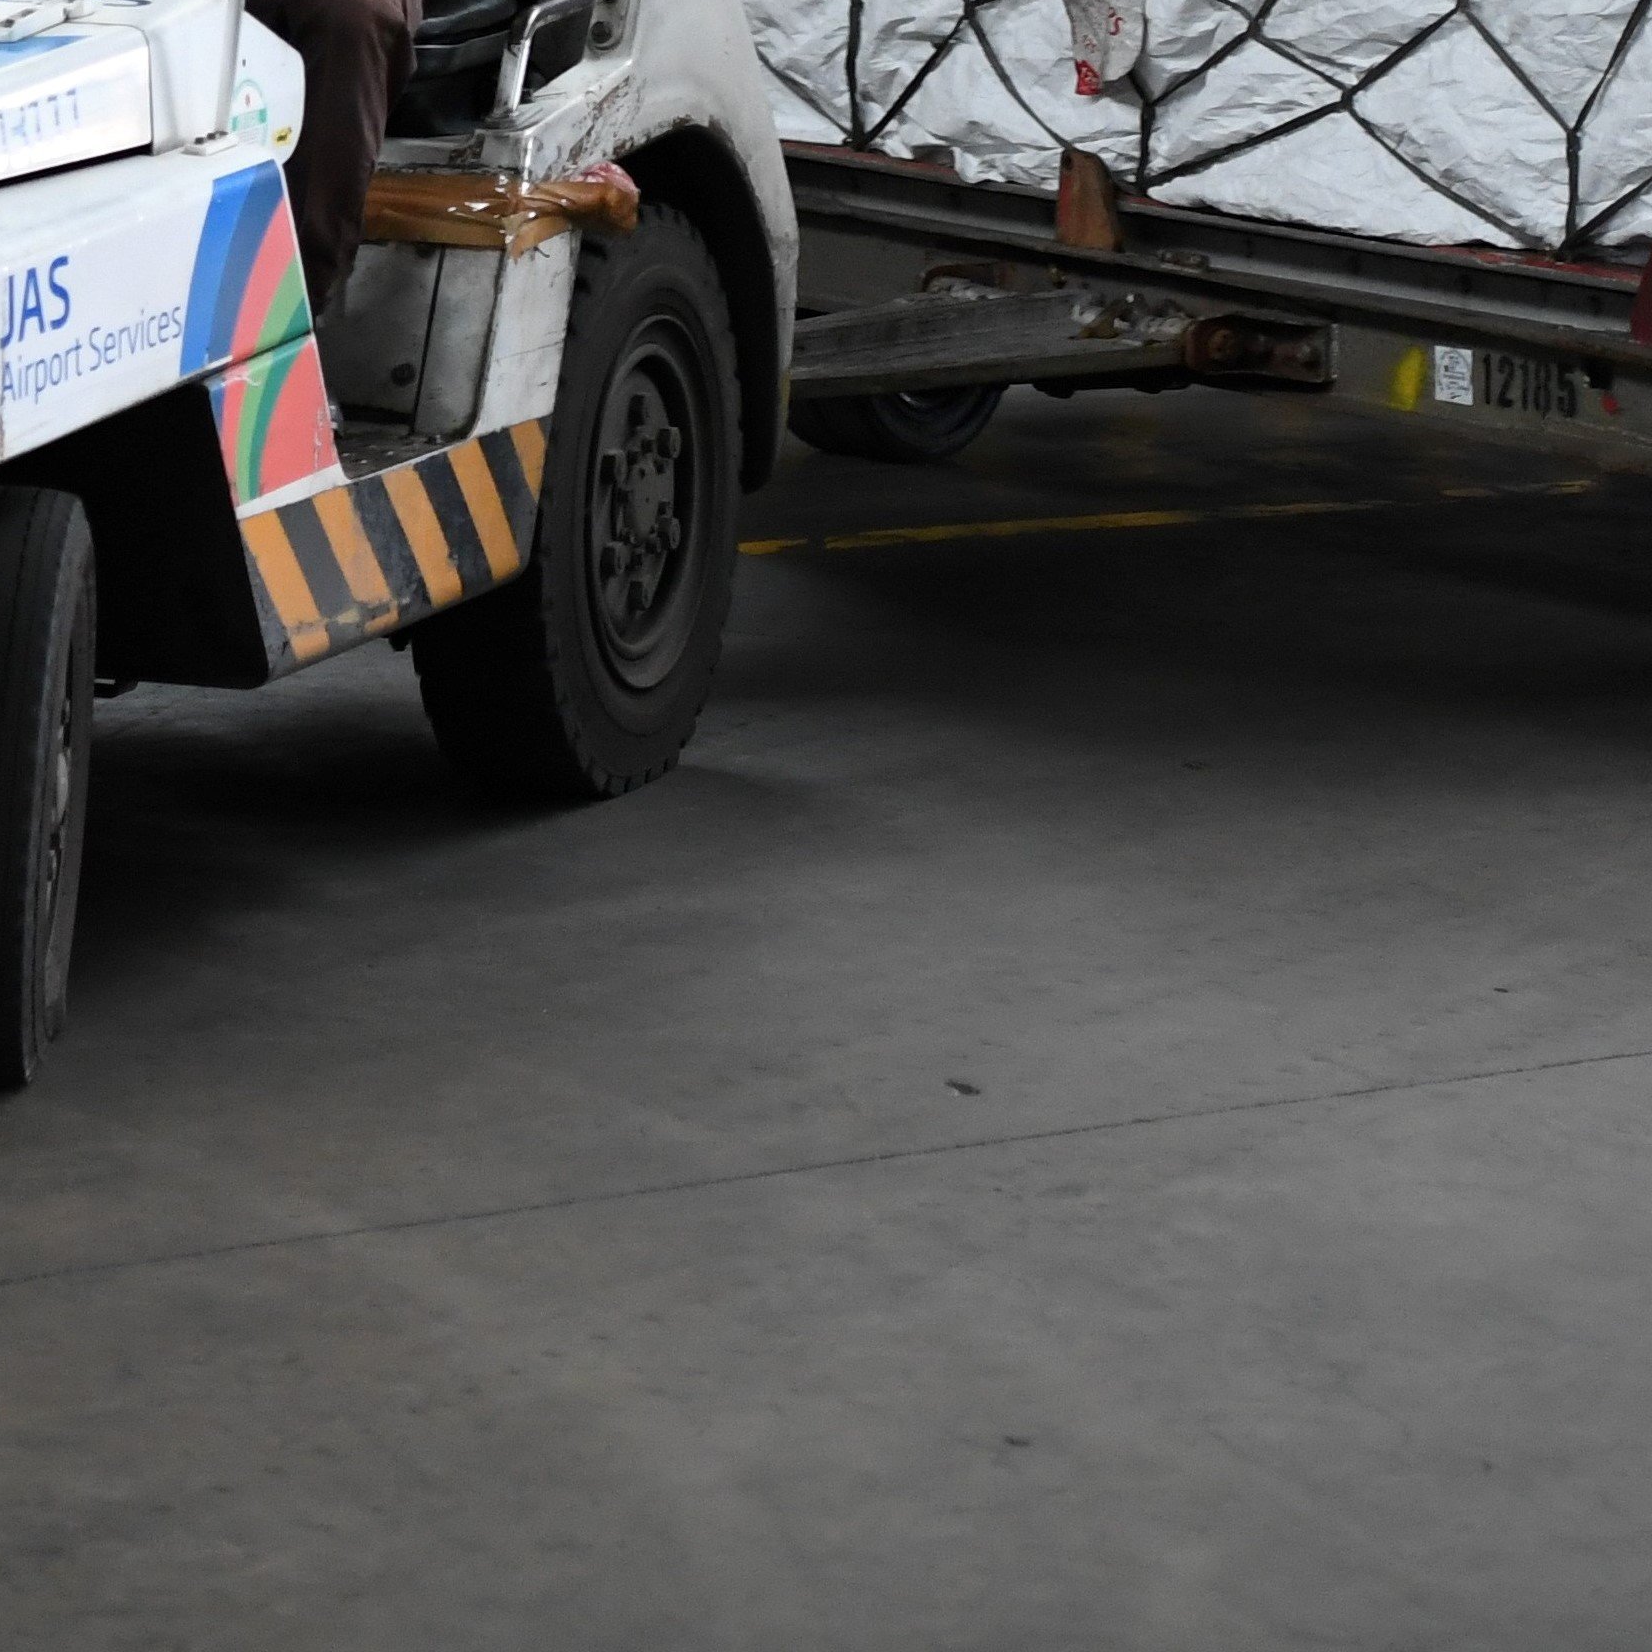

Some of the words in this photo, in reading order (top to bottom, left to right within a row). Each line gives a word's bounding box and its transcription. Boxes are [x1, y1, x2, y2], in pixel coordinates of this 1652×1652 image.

[0, 255, 71, 350] JAS
[0, 337, 84, 405] Airport
[89, 305, 183, 372] Services
